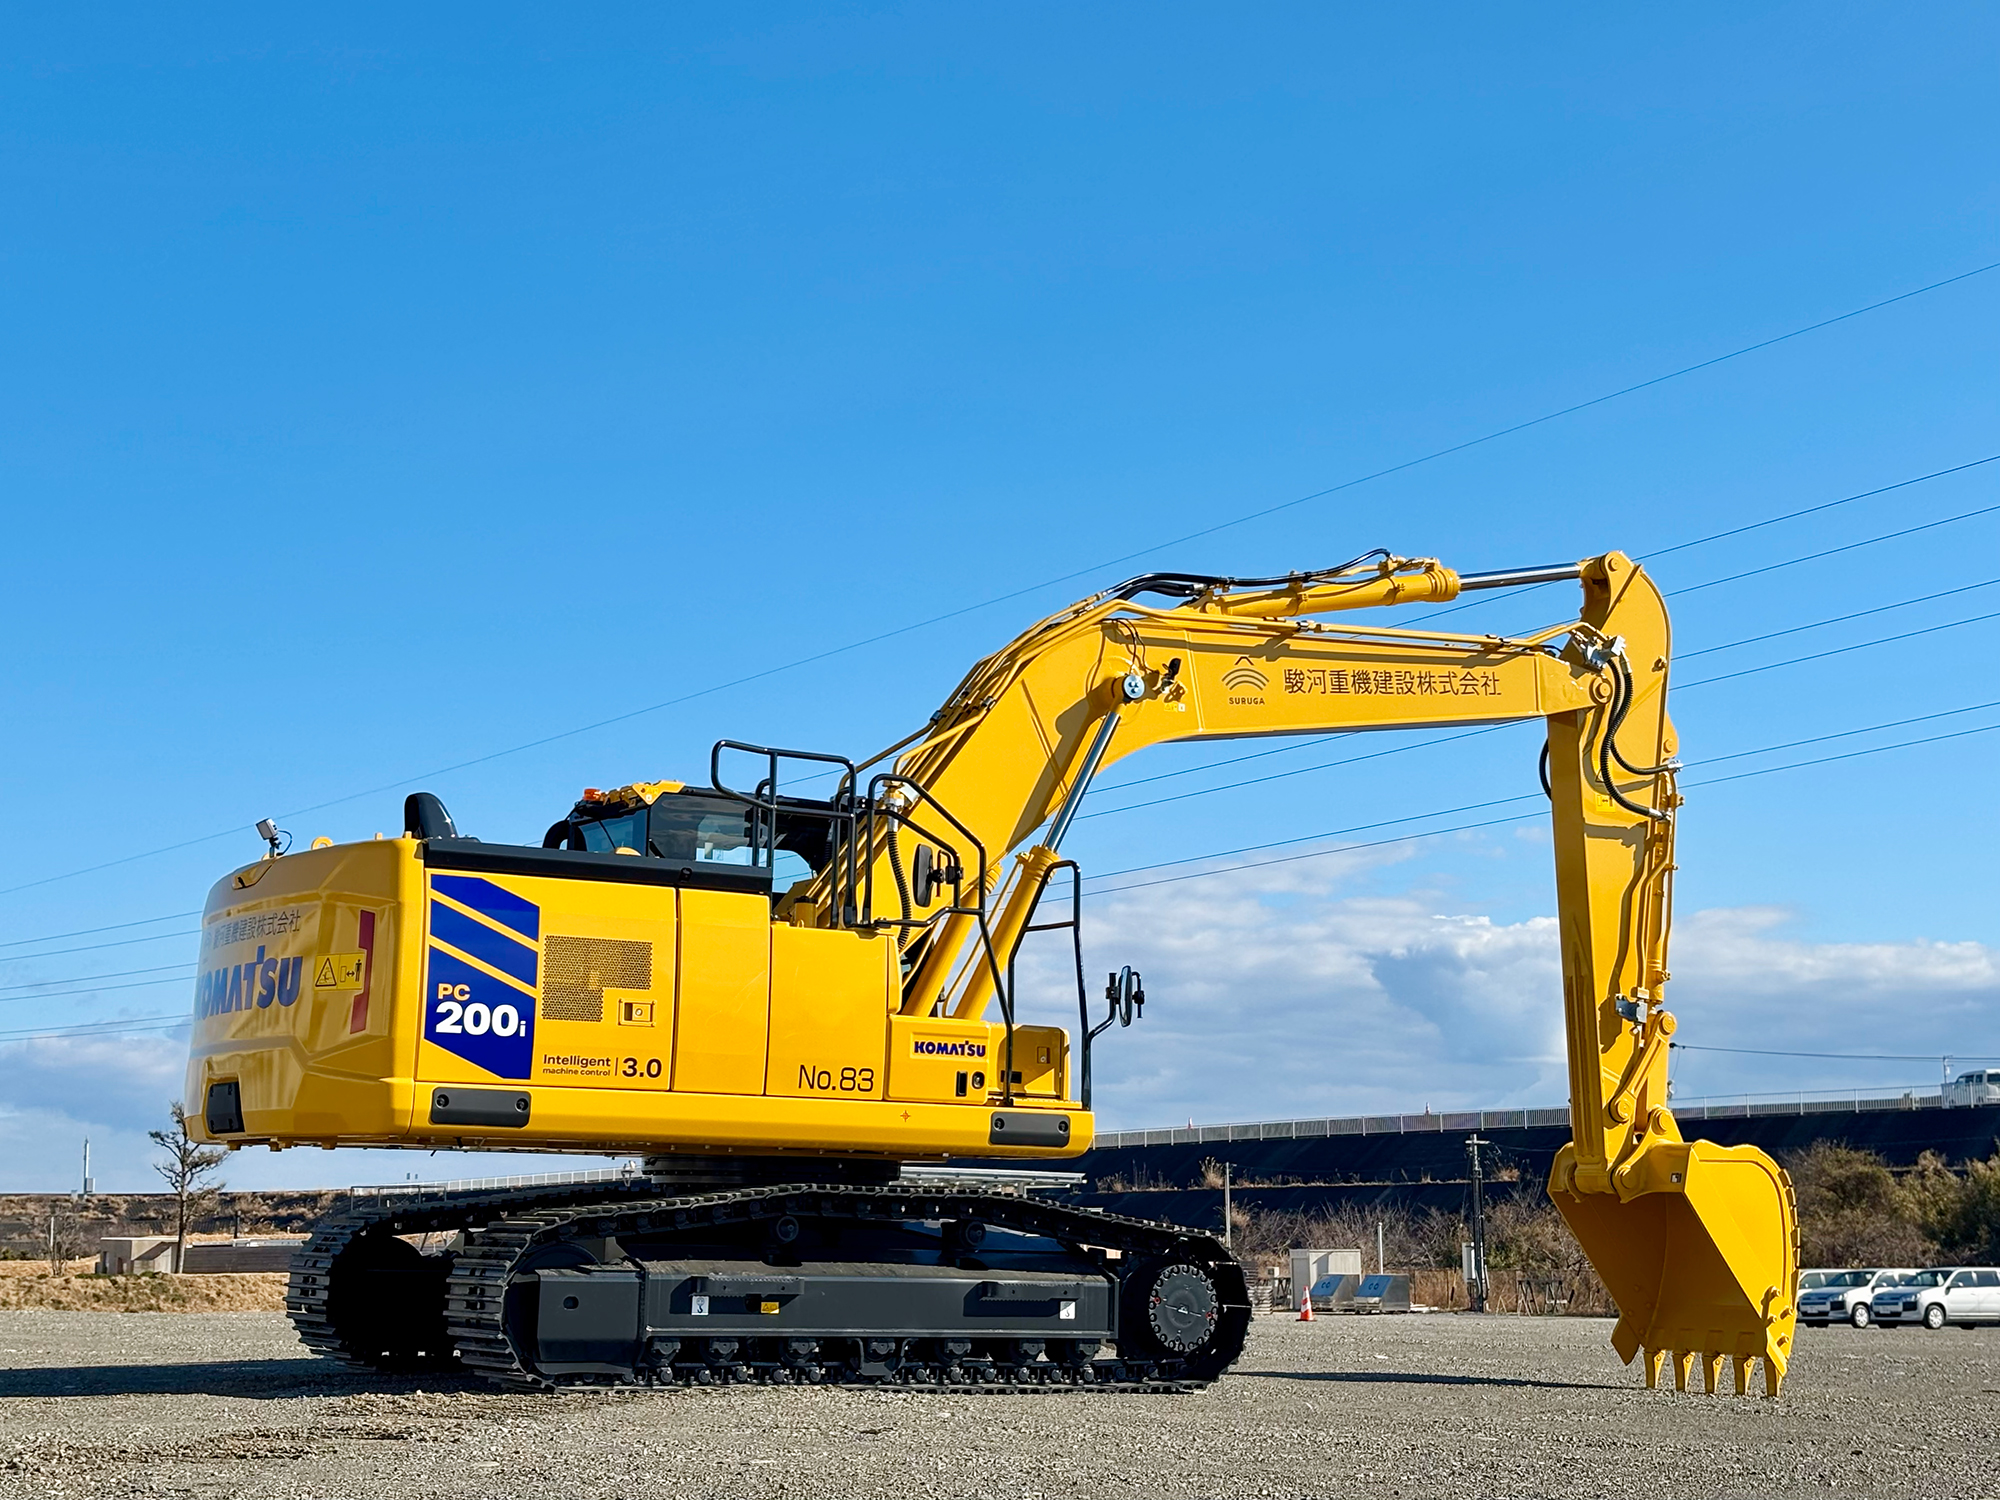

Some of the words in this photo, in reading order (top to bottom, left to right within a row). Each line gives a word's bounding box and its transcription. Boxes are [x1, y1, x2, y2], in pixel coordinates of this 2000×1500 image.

[1283, 668, 1502, 696] 駿河重機建設株式会社
[1228, 697, 1265, 705] SURUGA
[437, 983, 471, 1001] PC
[435, 1001, 526, 1037] 200i
[914, 1041, 986, 1057] KOMATSU
[542, 1067, 578, 1075] machine
[543, 1054, 611, 1068] Intelligent
[622, 1057, 662, 1078] 3.0
[798, 1064, 874, 1092] No.83
